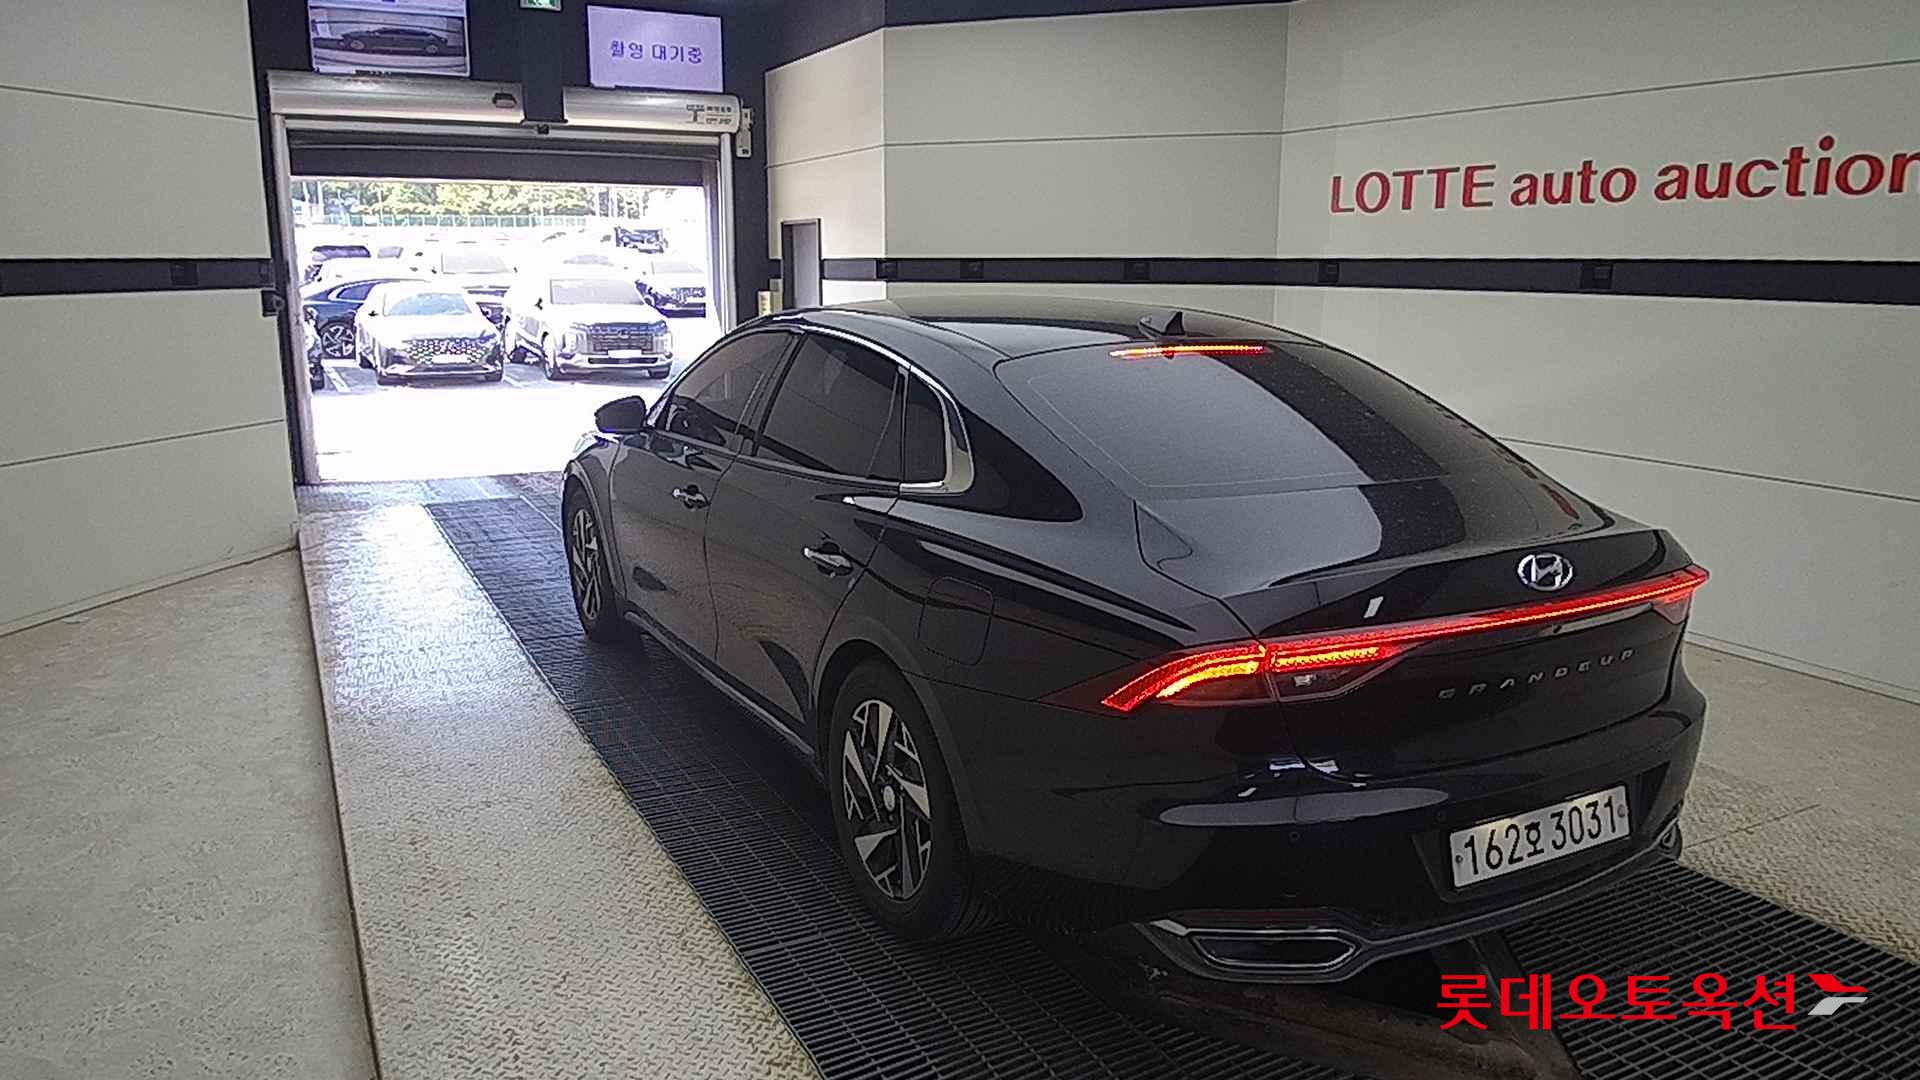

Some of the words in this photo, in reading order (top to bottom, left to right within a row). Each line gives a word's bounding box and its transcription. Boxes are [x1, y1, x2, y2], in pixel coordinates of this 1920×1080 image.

[1329, 163, 1497, 214] LOTTE
[1509, 160, 1637, 206] auto
[1653, 135, 1920, 201] auction
[1437, 649, 1634, 700] GRANDEUR
[1549, 795, 1617, 850] 3031
